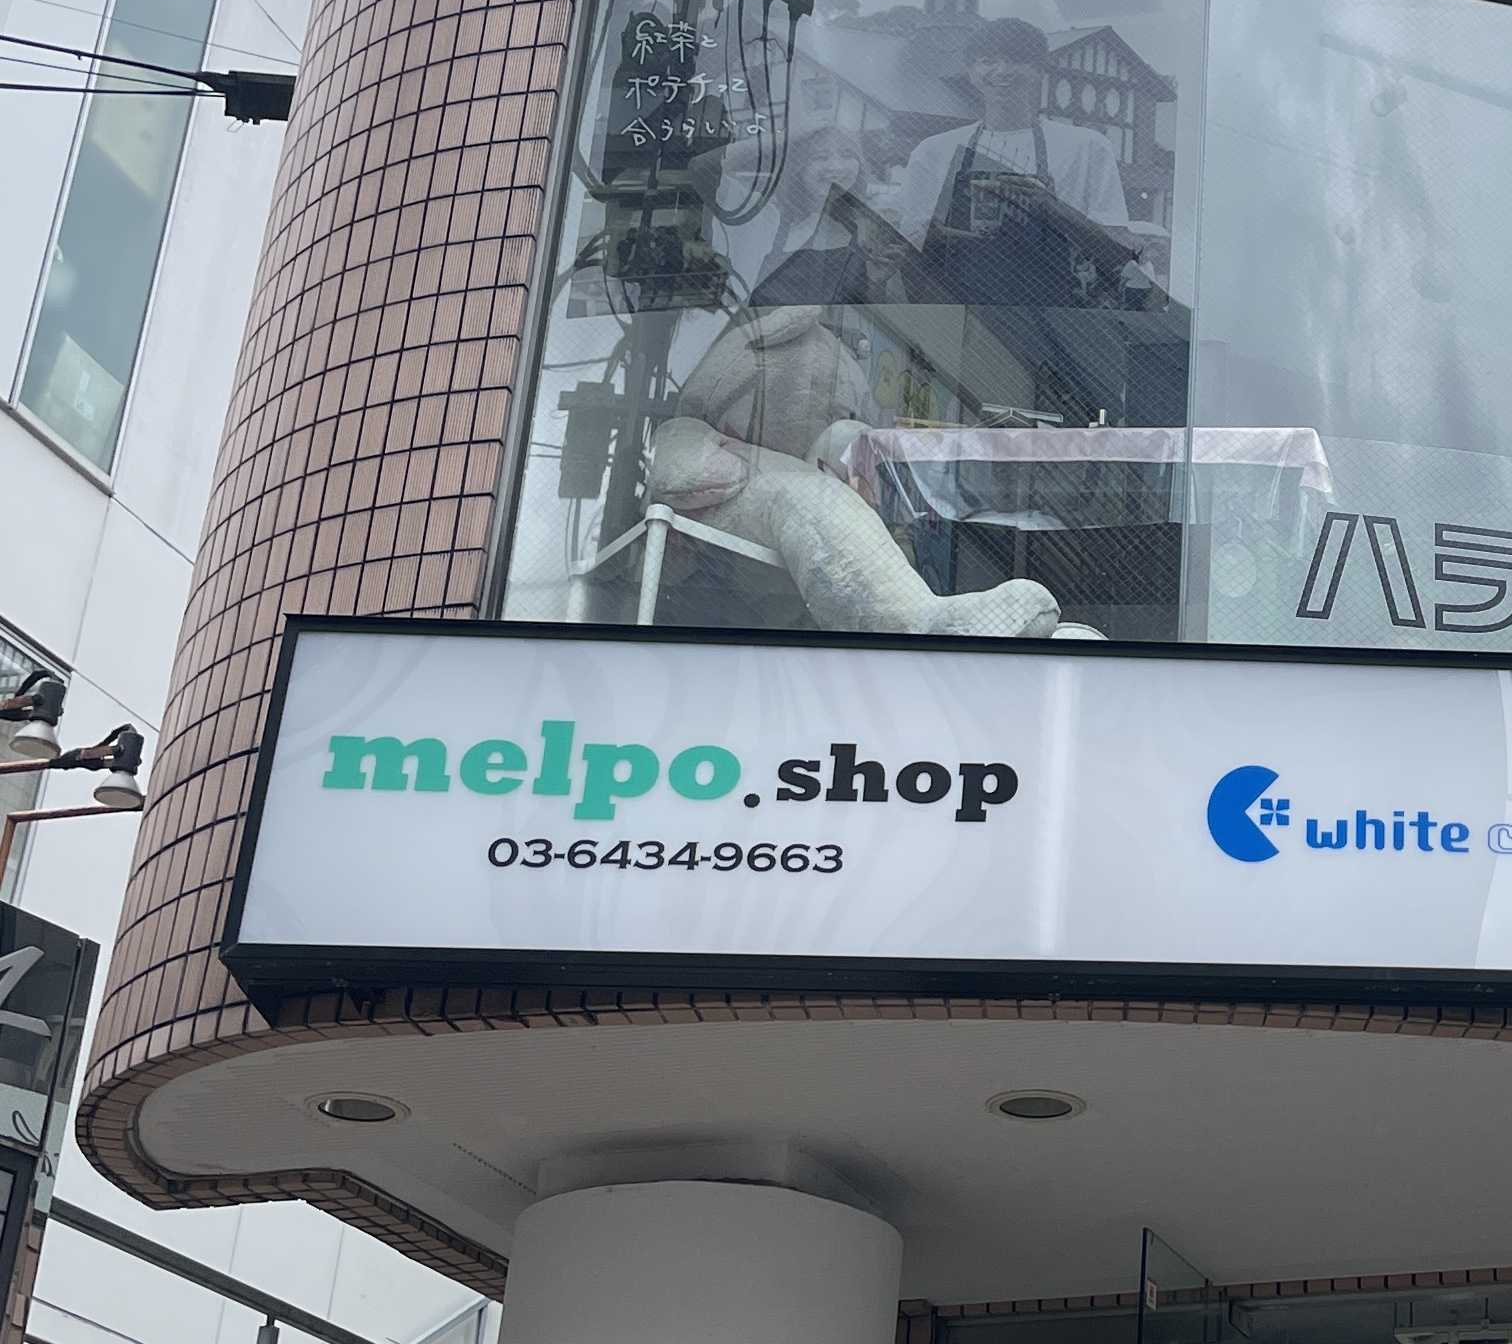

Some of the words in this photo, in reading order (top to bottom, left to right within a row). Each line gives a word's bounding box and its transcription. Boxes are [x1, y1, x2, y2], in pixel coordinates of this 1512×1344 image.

[632, 20, 718, 65] 紅茶と
[625, 73, 749, 110] ポテチって
[1306, 809, 1470, 854] white
[487, 837, 844, 874] 03-6434-9663
